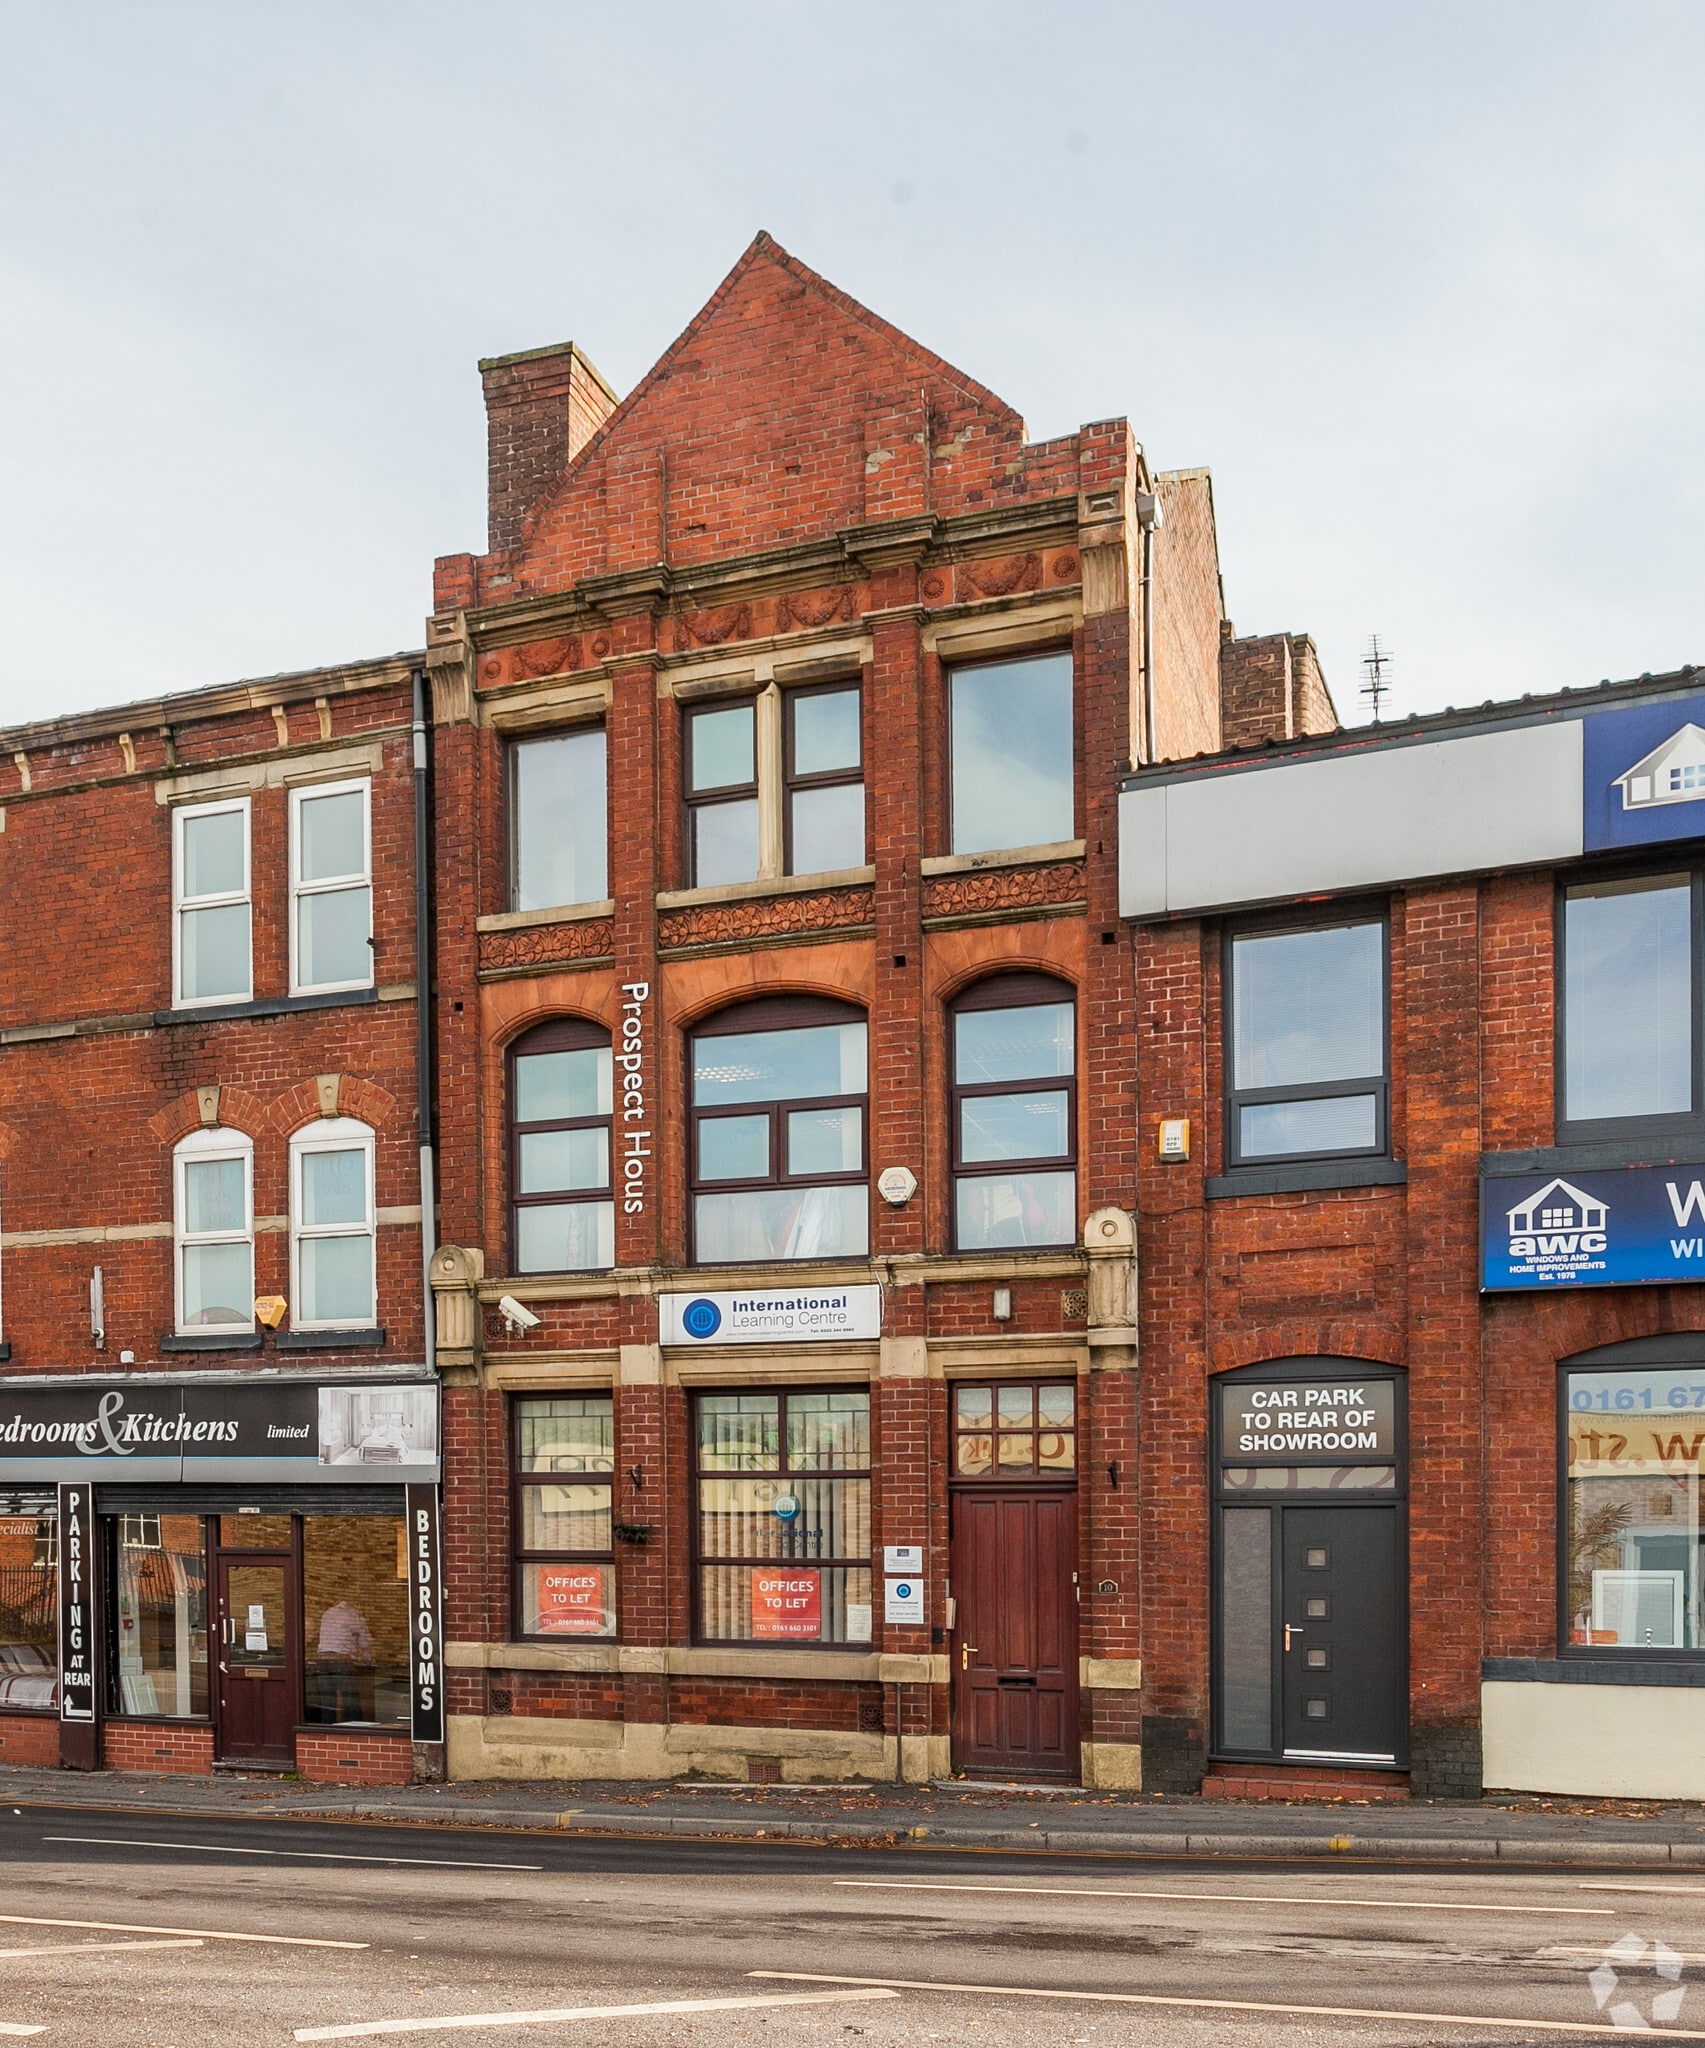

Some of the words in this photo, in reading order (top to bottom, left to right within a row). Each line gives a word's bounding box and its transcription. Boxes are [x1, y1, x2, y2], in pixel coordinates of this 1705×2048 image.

[615, 981, 649, 1122] Prospect
[623, 1130, 651, 1214] Hous
[1665, 1180, 1705, 1228] W
[1508, 1233, 1607, 1256] awc
[1670, 1238, 1703, 1259] WI
[1525, 1255, 1569, 1264] WINDOWS
[1570, 1253, 1589, 1262] AND
[1509, 1265, 1535, 1274] HOME
[1536, 1262, 1606, 1272] IMPROVEMENTS
[1539, 1273, 1555, 1281] Est.
[1556, 1272, 1576, 1280] 1978
[732, 1295, 847, 1313] International
[732, 1314, 794, 1329] Learning
[798, 1311, 847, 1325] Centre
[1251, 1390, 1300, 1409] CAR
[1304, 1388, 1365, 1407] PARK
[1572, 1387, 1652, 1410] 0161
[1667, 1386, 1705, 1408] 67
[74, 1391, 135, 1456] &
[122, 1413, 239, 1443] Kitchens
[266, 1423, 310, 1440] limited
[1242, 1412, 1272, 1430] TO
[1277, 1411, 1338, 1429] REAR
[1343, 1410, 1376, 1428] OF
[1239, 1432, 1378, 1452] SHOWROOM
[68, 1492, 84, 1650] PARKING
[545, 1577, 596, 1588] OFFICES
[759, 1580, 814, 1592] OFFICES
[1104, 1583, 1113, 1592] 10
[551, 1593, 567, 1603] TO
[570, 1593, 591, 1604] LET
[764, 1597, 782, 1608] TO
[786, 1597, 809, 1609] LET
[416, 1509, 435, 1711] BEDROOMS
[772, 1624, 788, 1632] 0161
[789, 1624, 801, 1632] 660
[802, 1624, 817, 1632] 3101
[70, 1655, 84, 1669] AT
[64, 1672, 91, 1687] REAR
